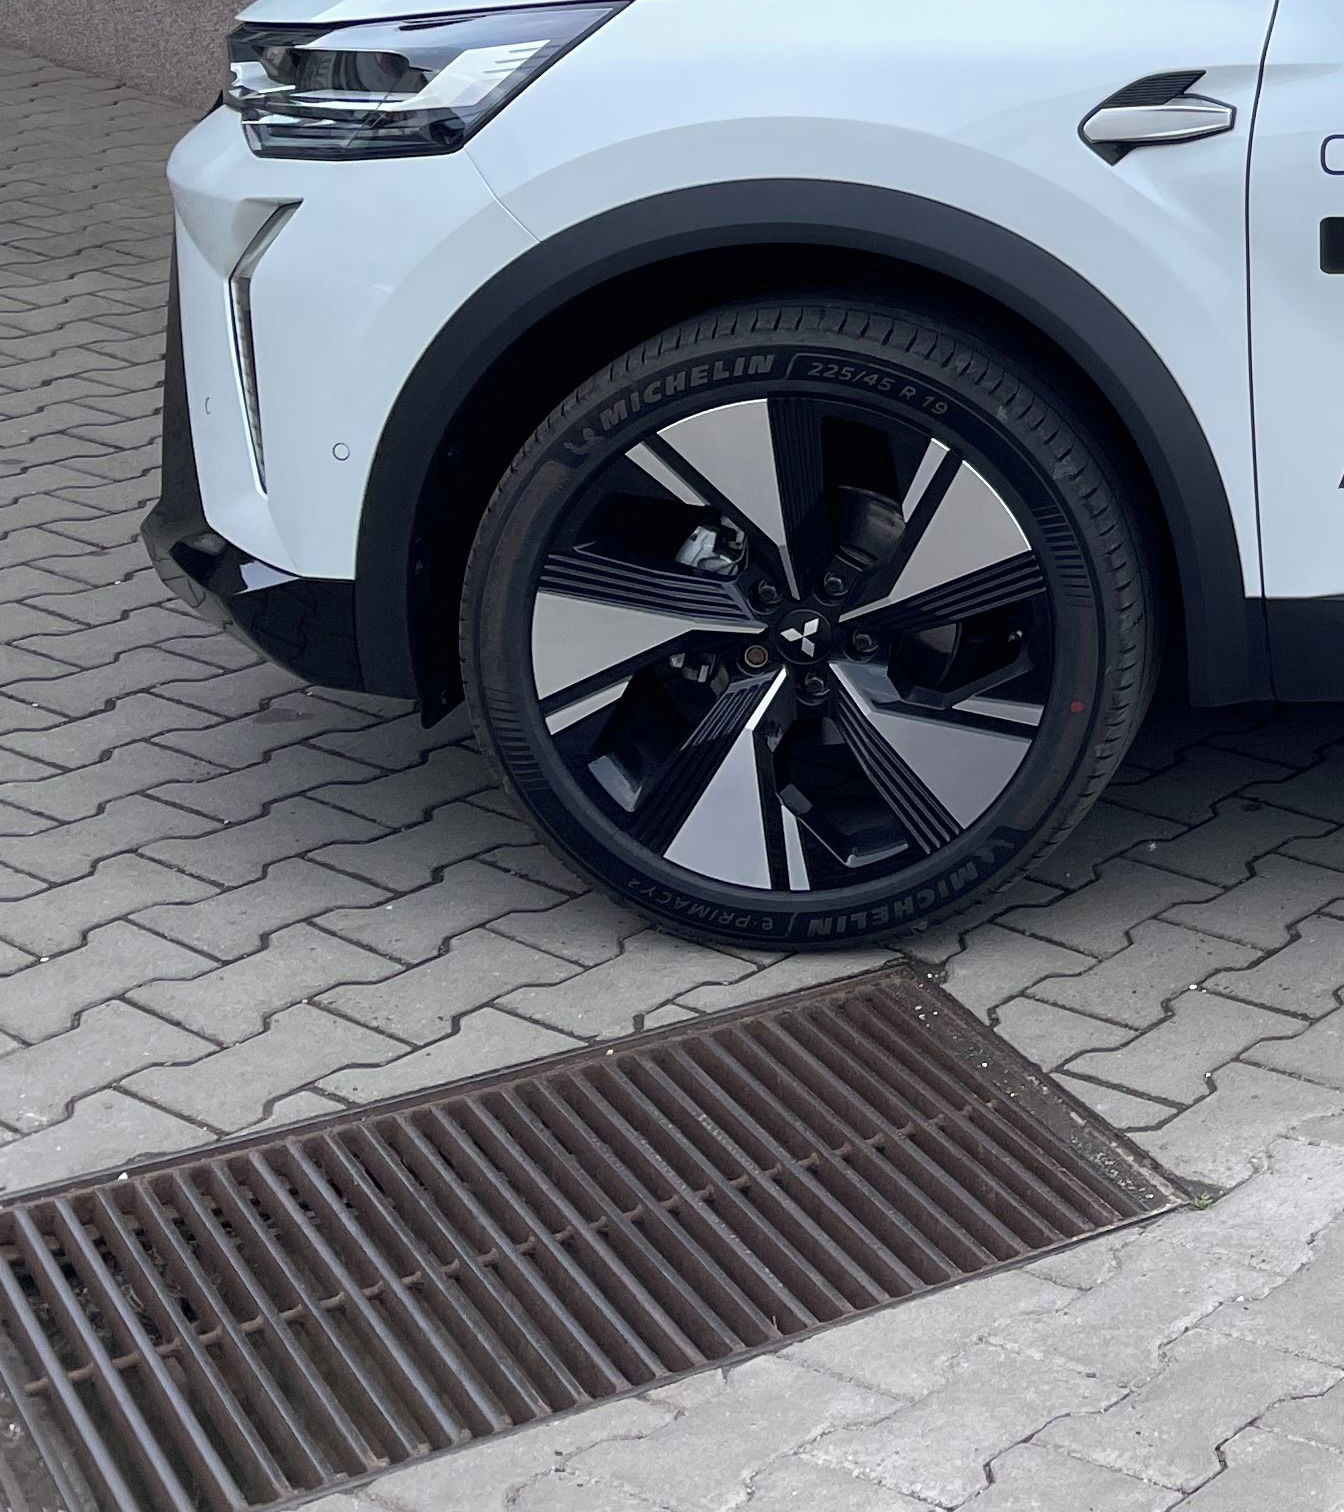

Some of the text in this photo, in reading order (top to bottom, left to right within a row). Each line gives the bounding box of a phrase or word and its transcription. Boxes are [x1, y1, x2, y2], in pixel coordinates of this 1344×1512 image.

[599, 353, 950, 432] MICHELIN 225/45 R 19
[807, 860, 979, 937] MICHELIN
